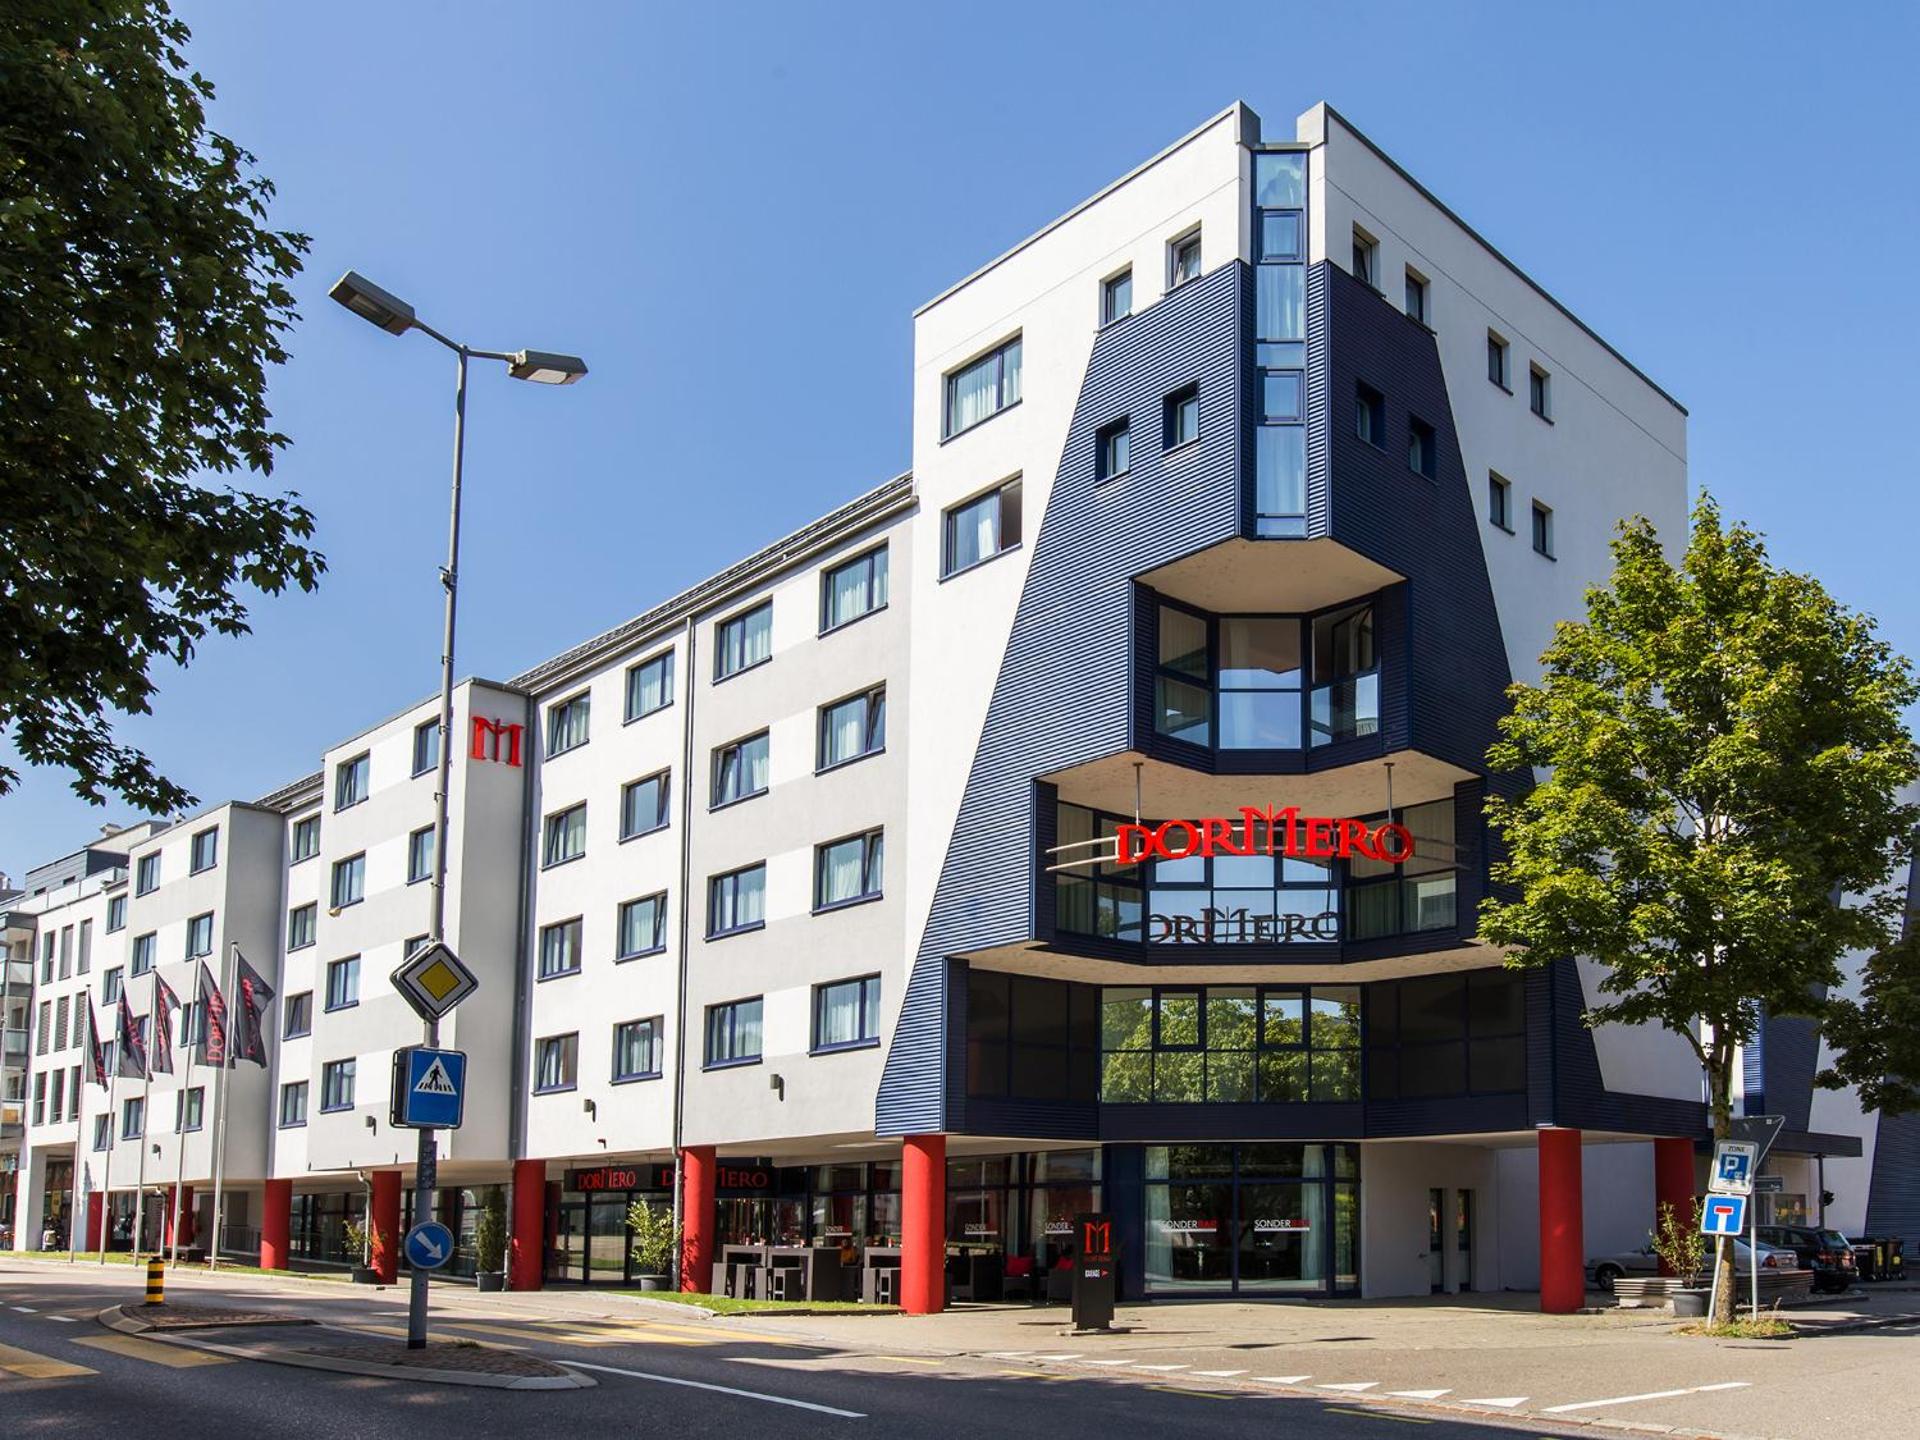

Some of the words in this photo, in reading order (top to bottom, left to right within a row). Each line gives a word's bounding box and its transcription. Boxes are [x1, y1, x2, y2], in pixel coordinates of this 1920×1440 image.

[1115, 801, 1414, 864] DORMERO
[578, 1168, 637, 1190] DORMERO
[661, 1167, 768, 1188] DERO
